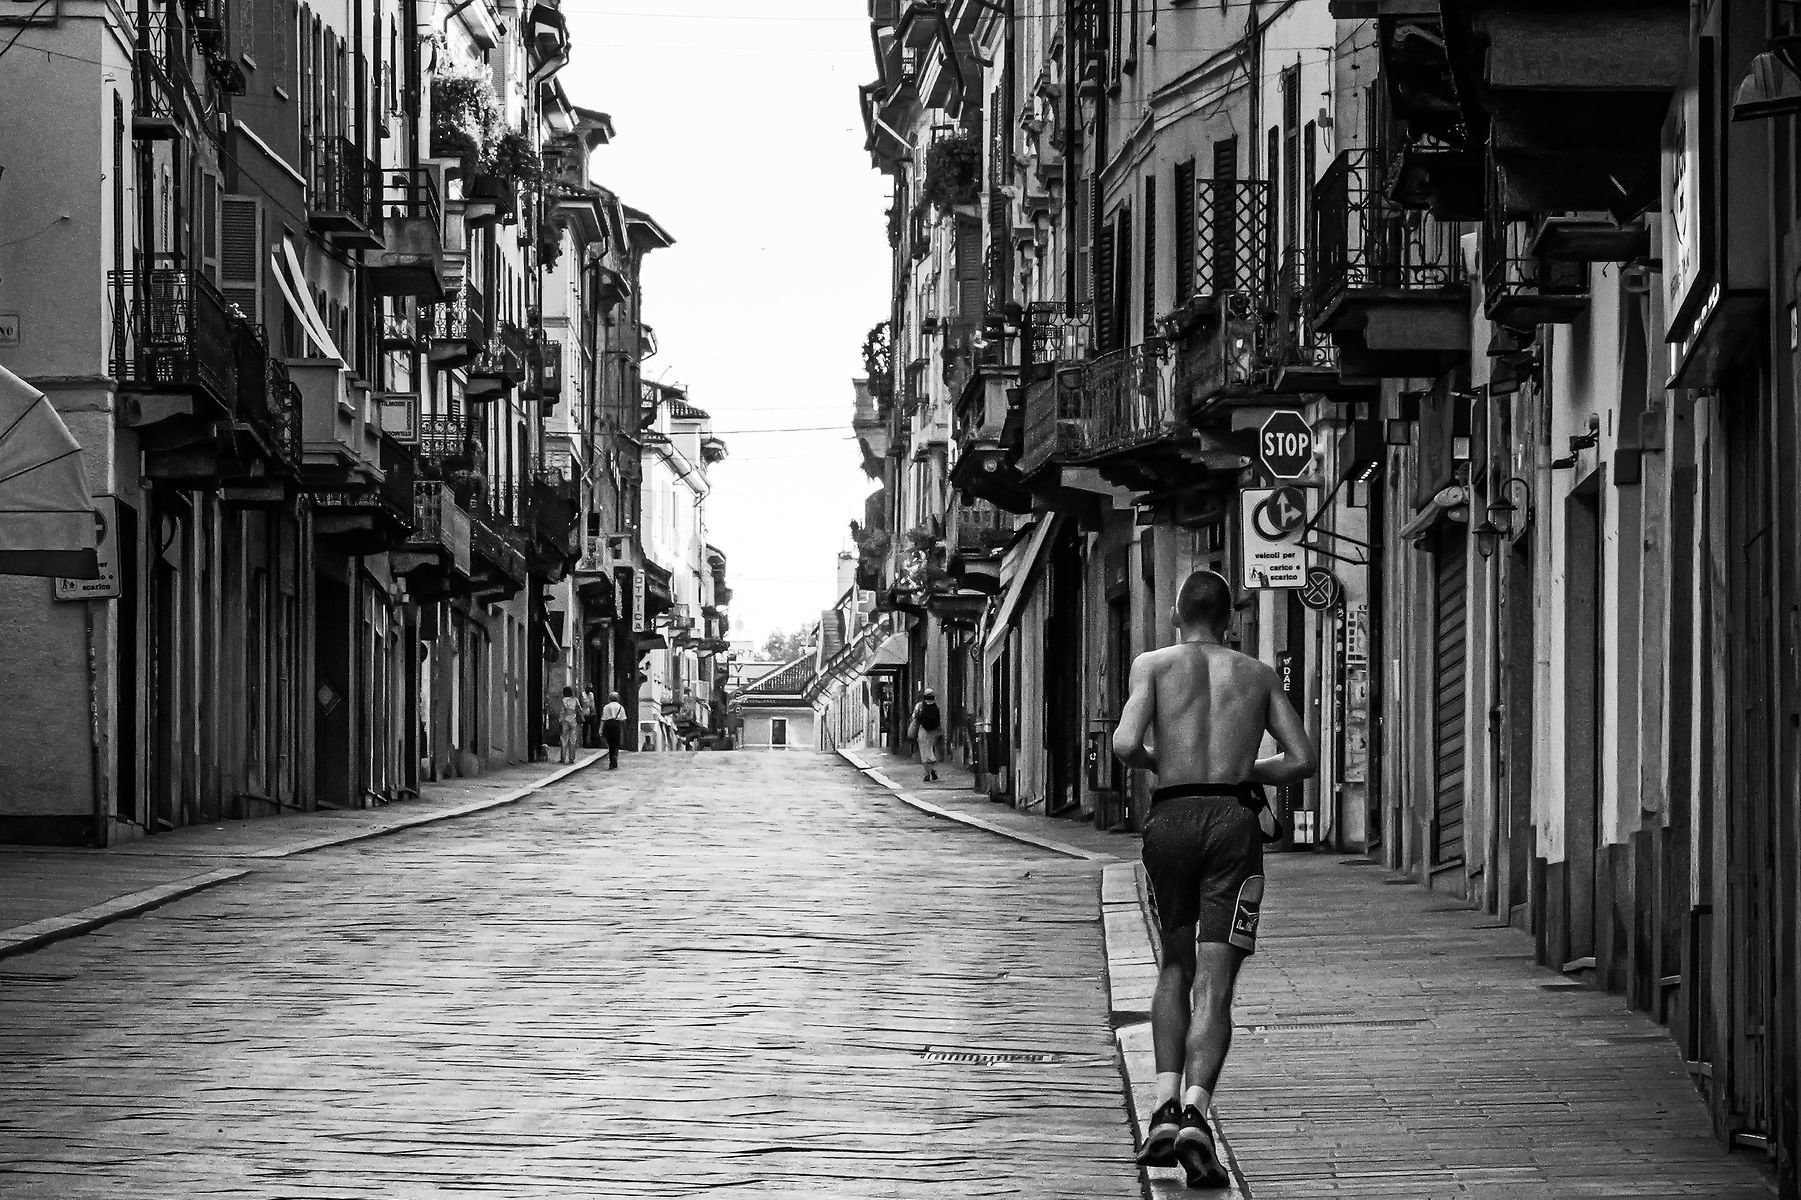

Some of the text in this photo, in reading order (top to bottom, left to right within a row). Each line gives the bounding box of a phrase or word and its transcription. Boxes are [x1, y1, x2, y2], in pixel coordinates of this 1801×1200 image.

[1264, 432, 1309, 457] STOP
[1282, 552, 1296, 560] per
[82, 583, 111, 591] scarico
[634, 577, 643, 630] OTTICA
[1283, 666, 1291, 691] DAE
